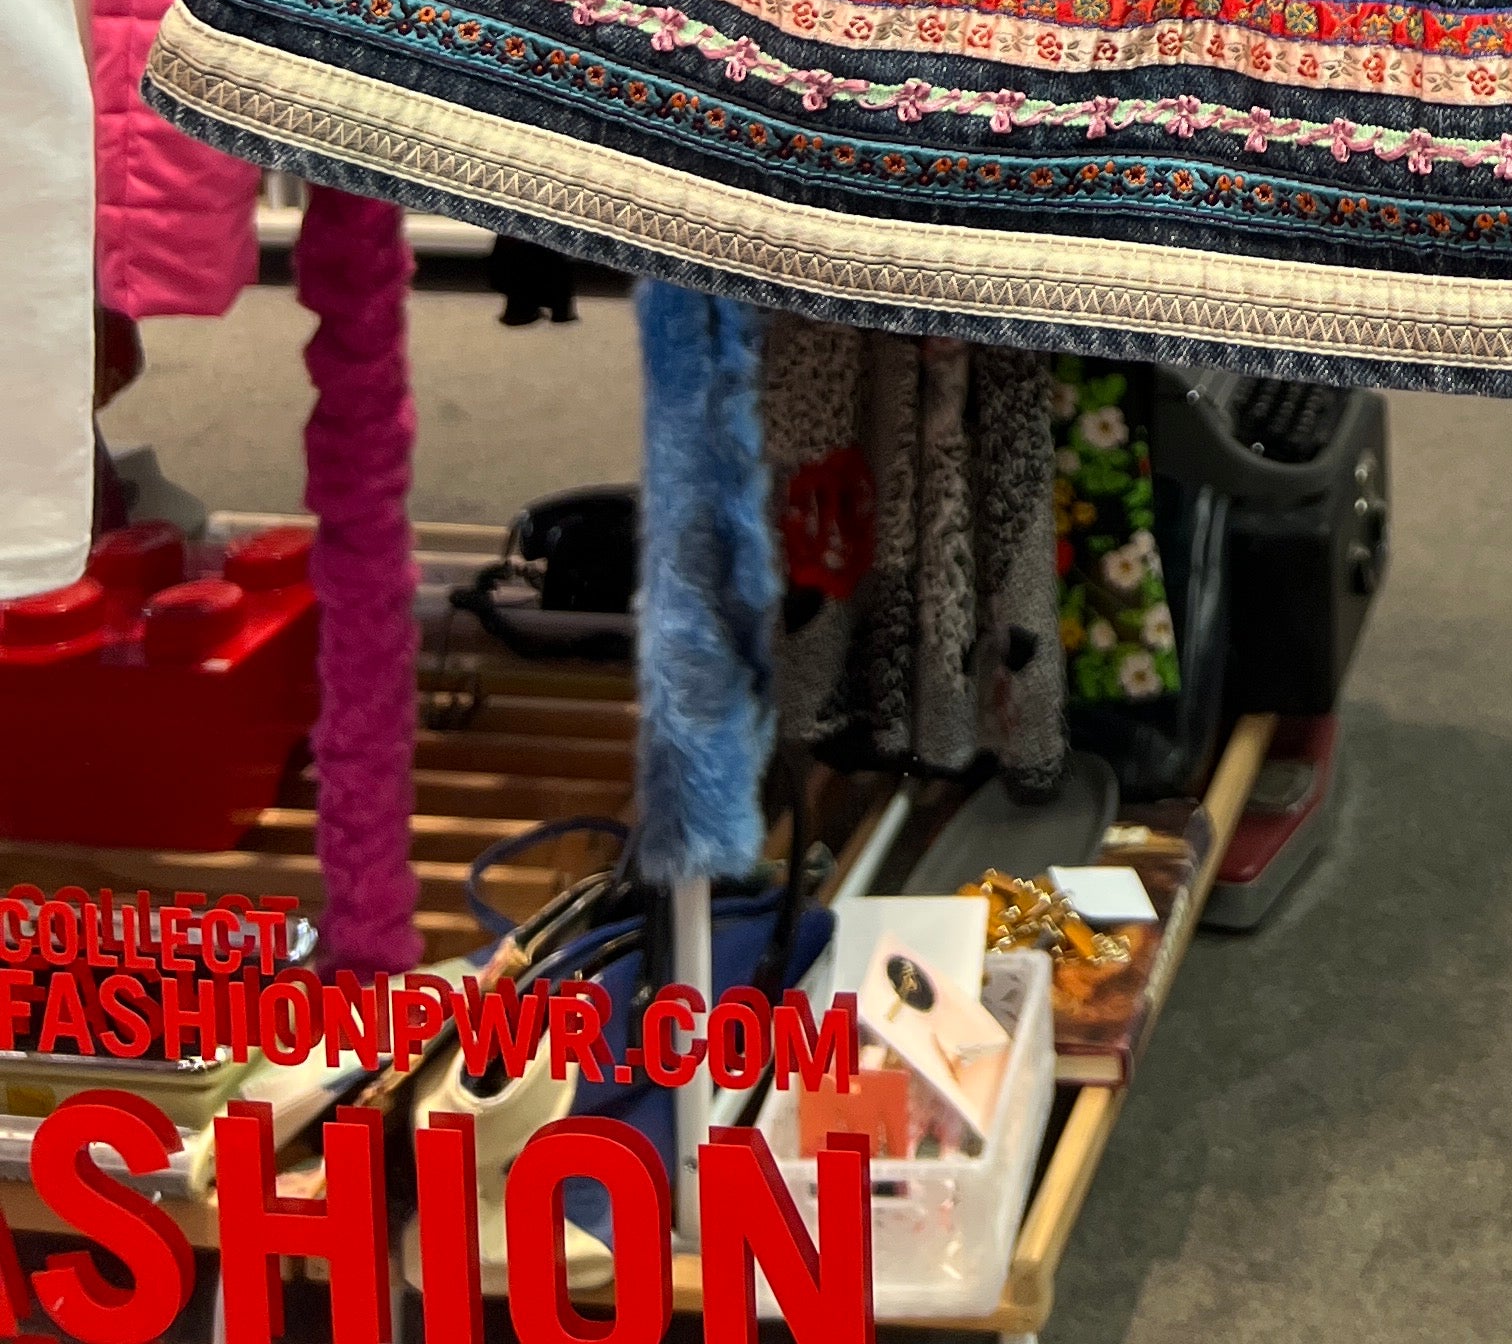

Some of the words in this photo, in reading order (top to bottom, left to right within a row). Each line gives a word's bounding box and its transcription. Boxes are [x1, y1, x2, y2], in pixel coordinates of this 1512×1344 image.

[0, 898, 287, 975] COLLECT
[0, 969, 852, 1094] FASHIONPWR.COM
[0, 1104, 868, 1344] SHION
